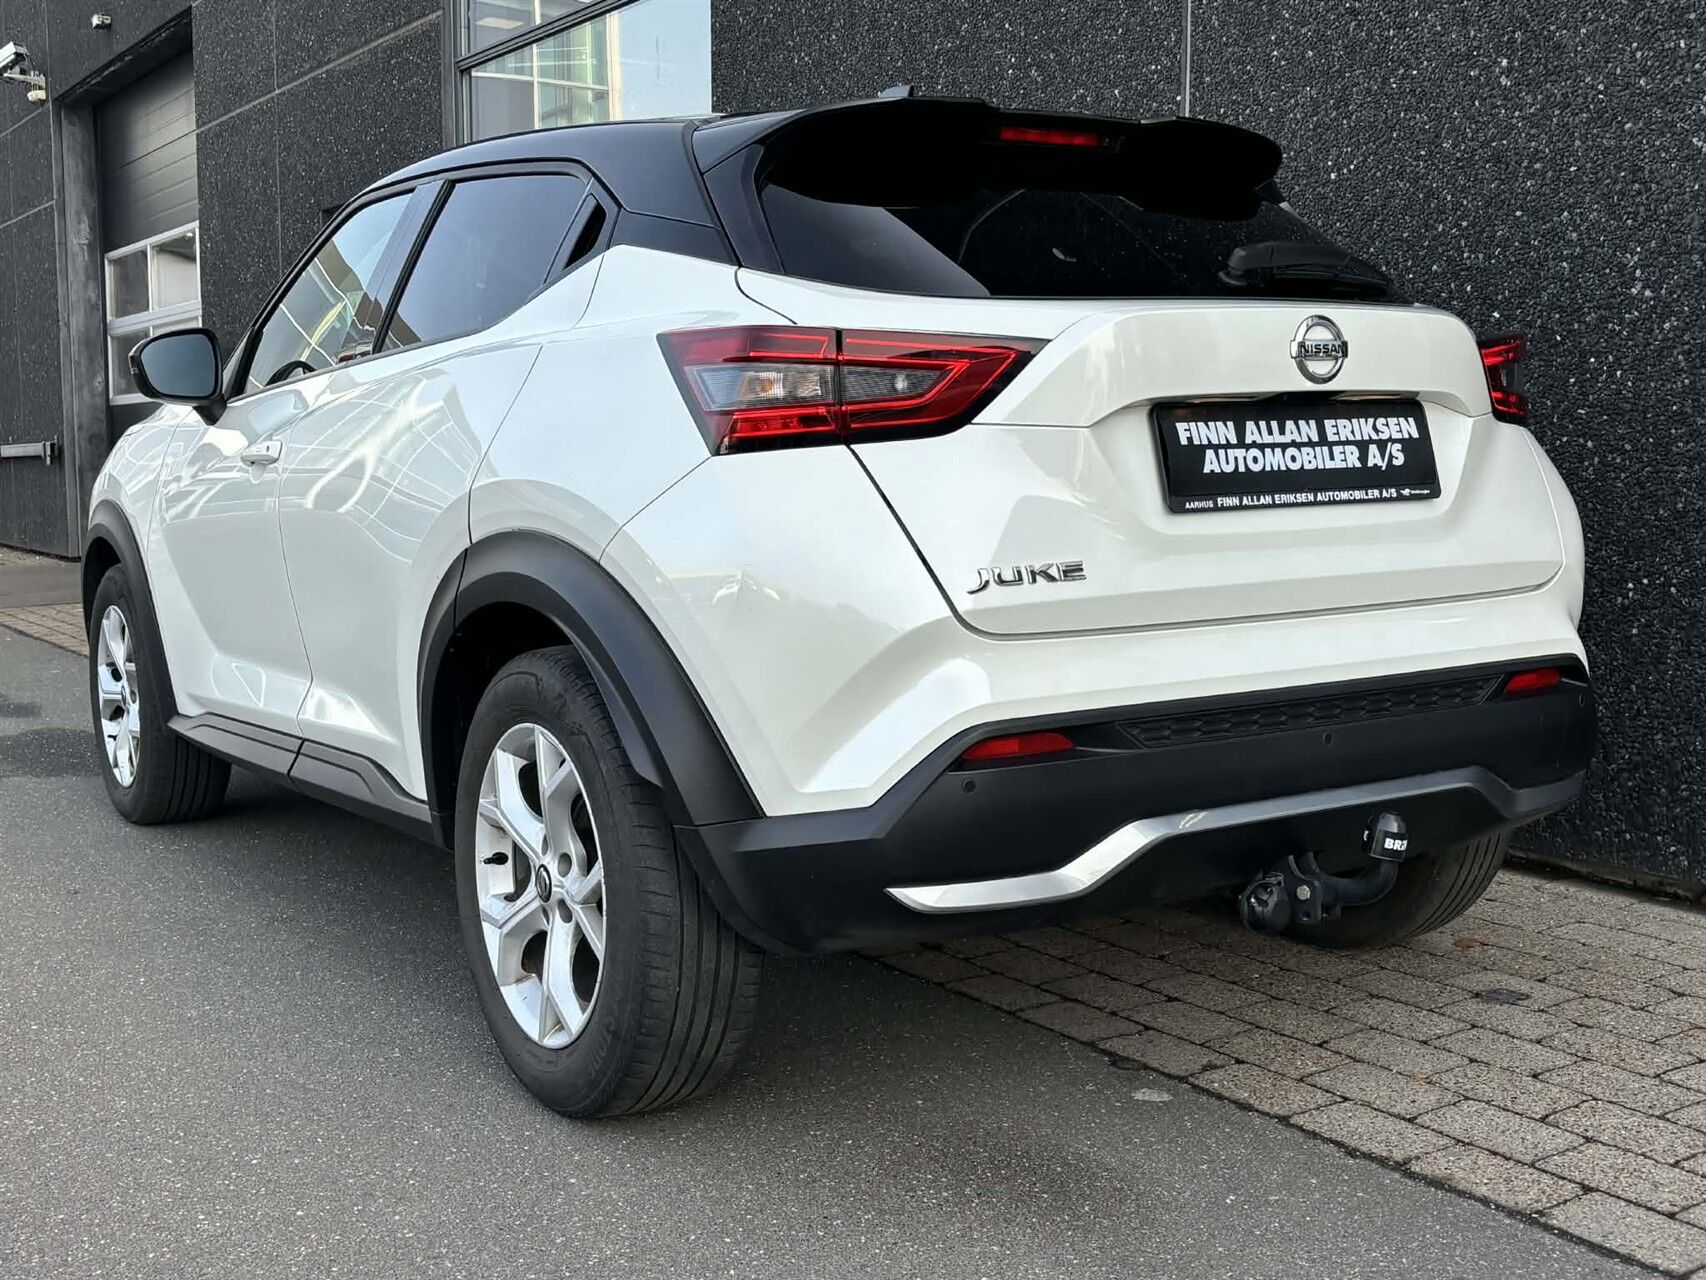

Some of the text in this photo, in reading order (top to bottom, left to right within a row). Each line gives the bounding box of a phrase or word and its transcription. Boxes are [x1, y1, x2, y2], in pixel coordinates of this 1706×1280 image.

[1299, 342, 1345, 355] NISSAN
[1175, 417, 1420, 446] FINN ALLAN ERIKSEN
[1203, 442, 1405, 474] AUTOMOBILER A/S
[1184, 500, 1214, 509] AARHUS
[1217, 496, 1240, 508] FINN
[1242, 494, 1273, 506] ALLAN
[1274, 491, 1315, 504] ERIKSEN
[1316, 488, 1381, 502] AUTOMOBILER
[1382, 487, 1398, 499] A/S
[967, 561, 1087, 595] JUKE
